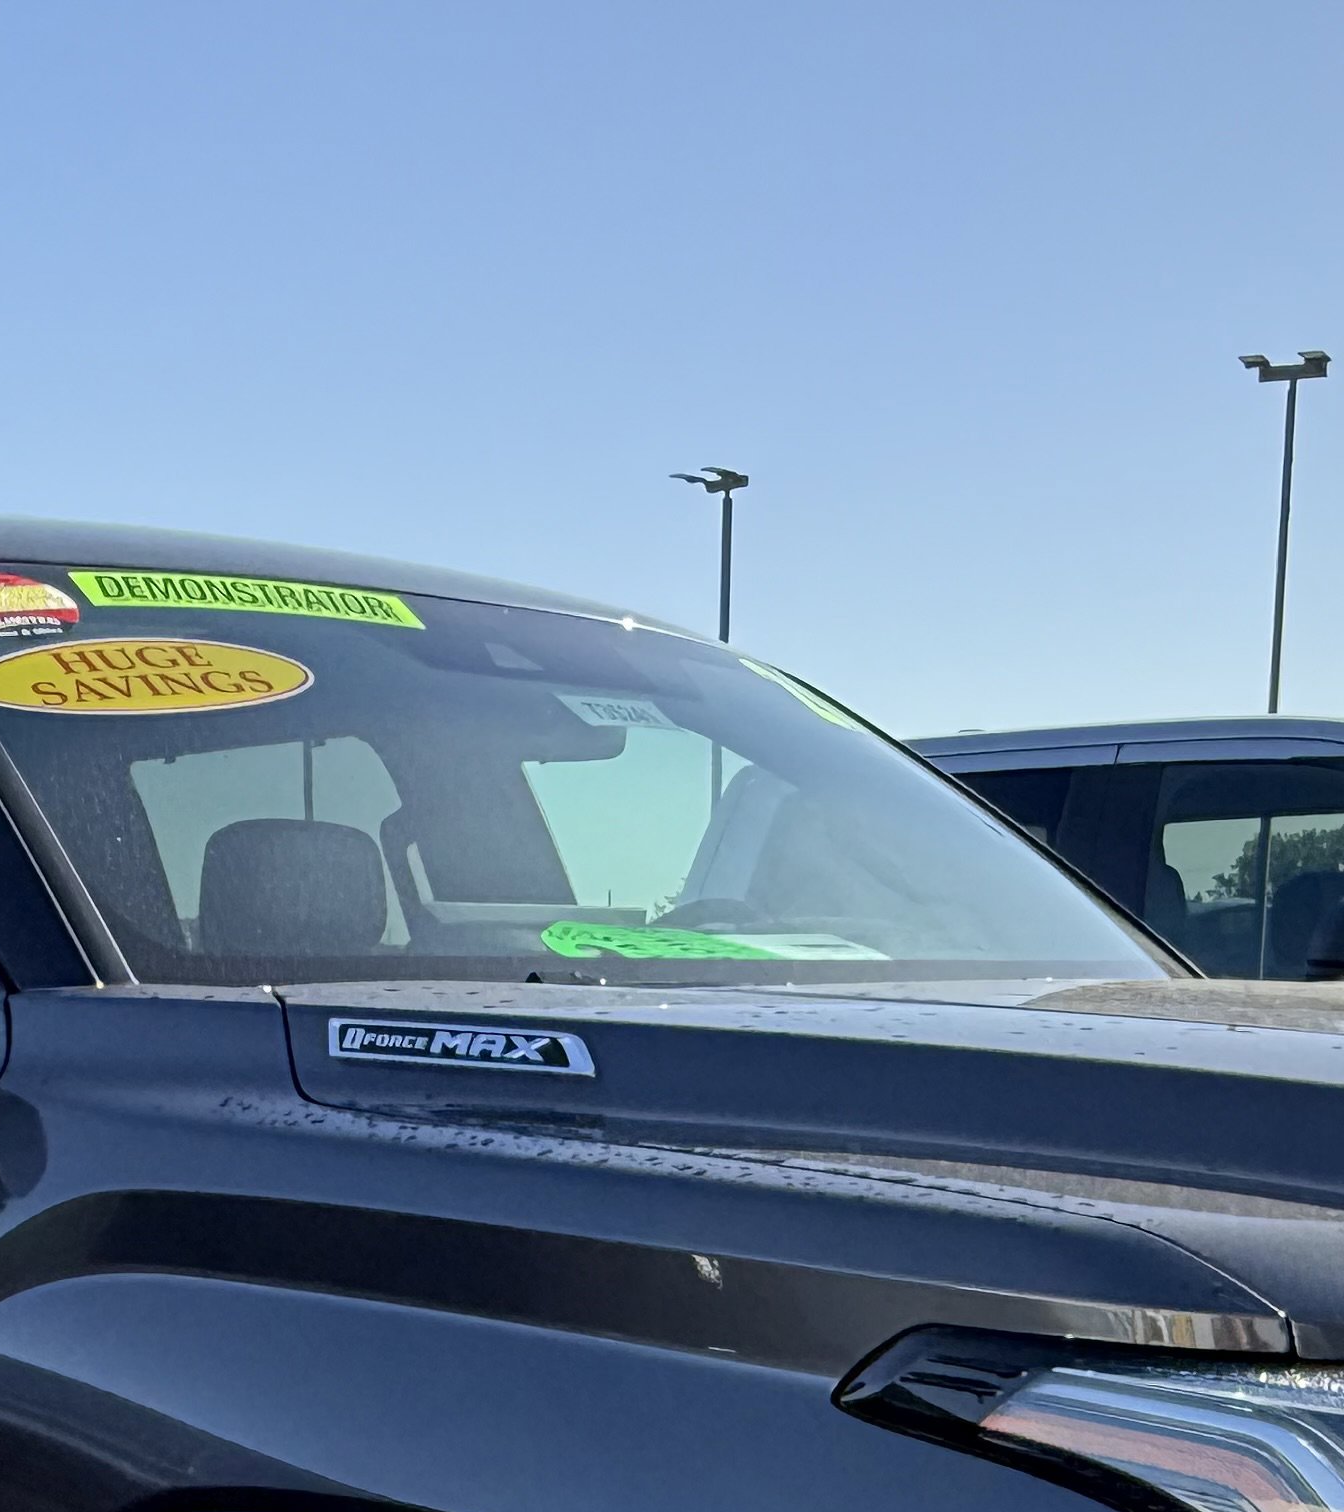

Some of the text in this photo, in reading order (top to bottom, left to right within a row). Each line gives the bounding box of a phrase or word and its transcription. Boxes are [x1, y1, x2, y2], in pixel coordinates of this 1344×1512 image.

[94, 574, 403, 624] DEMONSTRATOR
[48, 644, 213, 676] HUGE
[32, 669, 275, 707] SAVINGS
[429, 1030, 552, 1063] MAX
